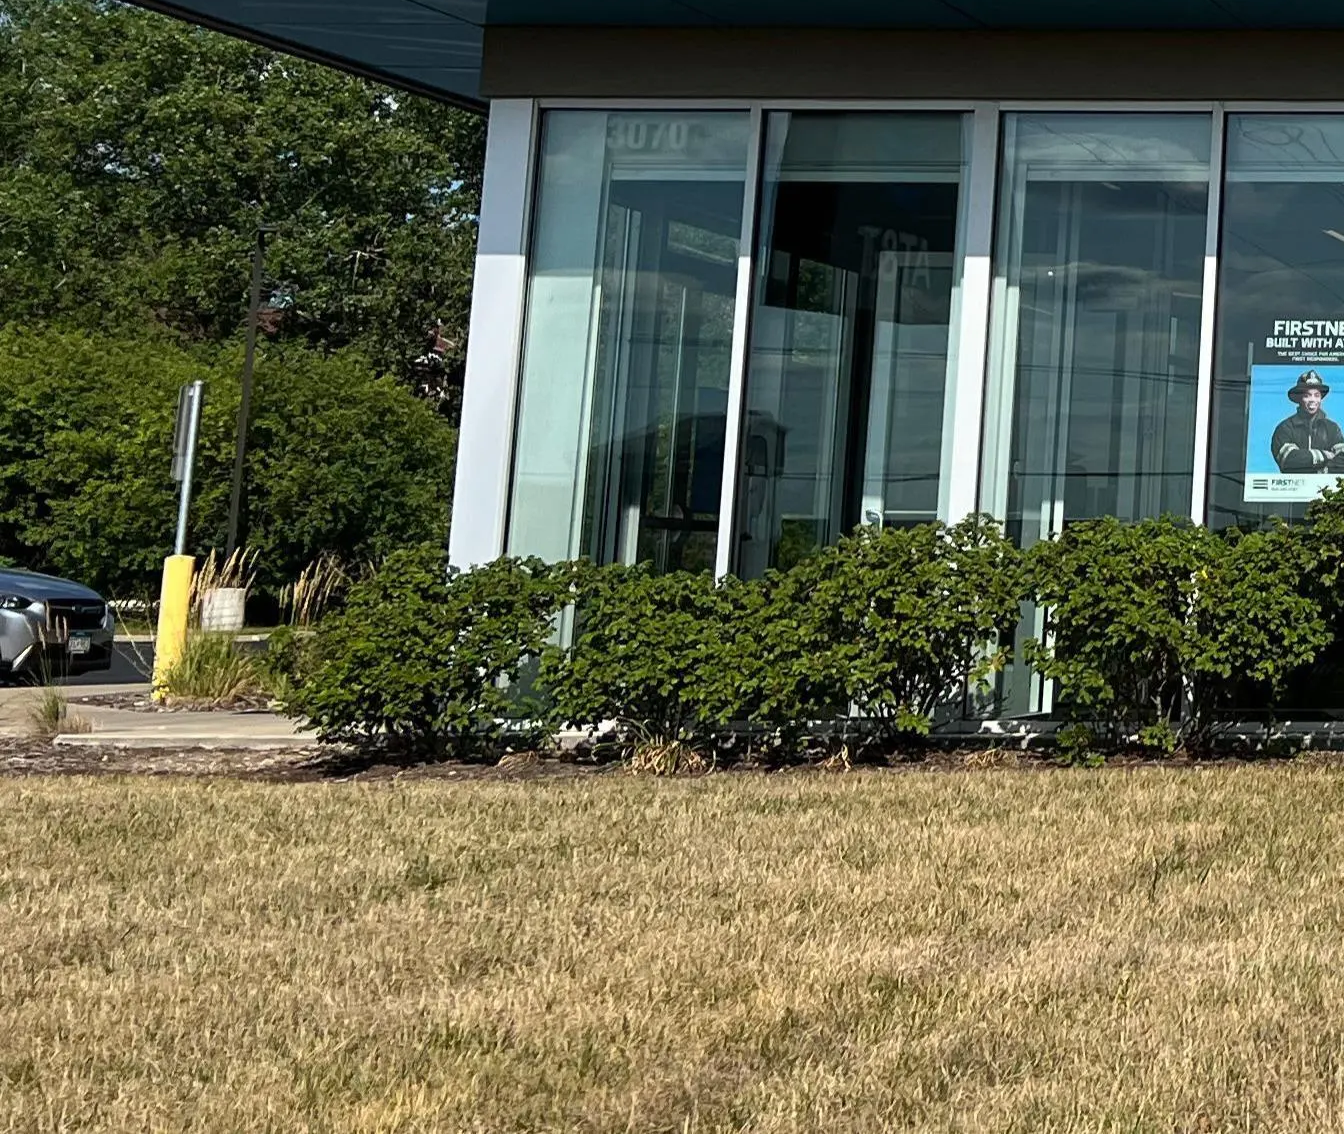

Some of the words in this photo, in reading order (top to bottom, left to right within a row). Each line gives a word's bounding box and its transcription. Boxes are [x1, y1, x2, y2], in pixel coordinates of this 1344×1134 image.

[607, 120, 689, 150] 3070
[1265, 337, 1298, 348] BUILT
[1301, 337, 1333, 348] WITH
